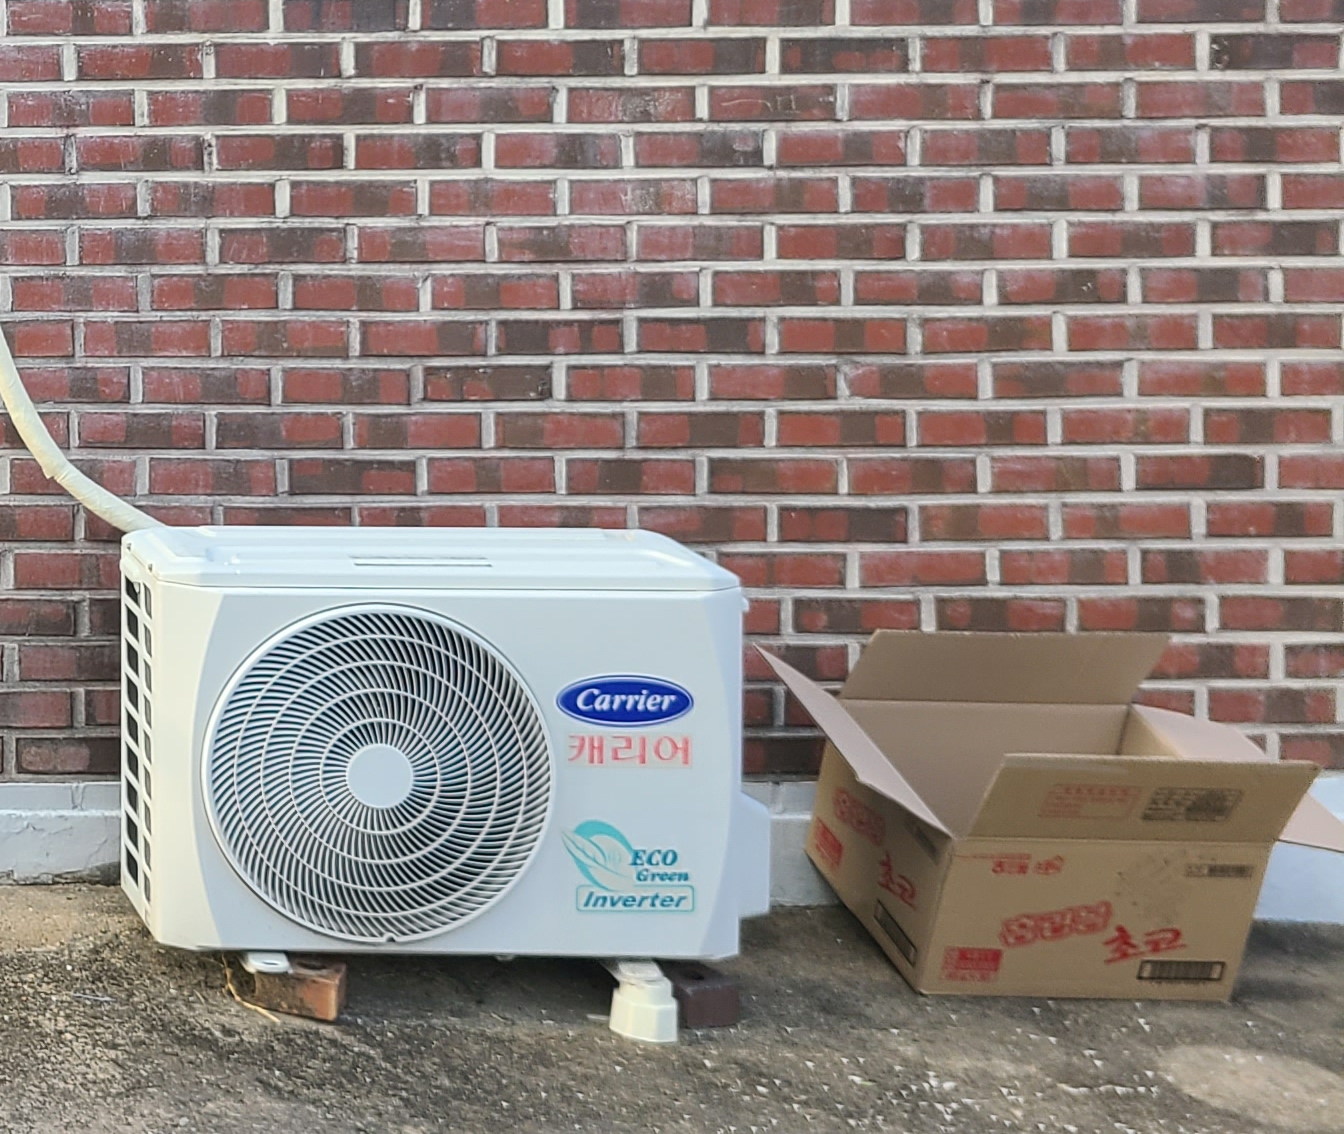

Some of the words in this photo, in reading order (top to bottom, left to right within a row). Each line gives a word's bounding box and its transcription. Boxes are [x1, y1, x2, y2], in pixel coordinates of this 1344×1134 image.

[576, 688, 677, 712] Carrier
[567, 734, 692, 766] 캐리어
[629, 849, 678, 867] ECO
[635, 869, 690, 883] Green
[583, 891, 687, 909] Inverter
